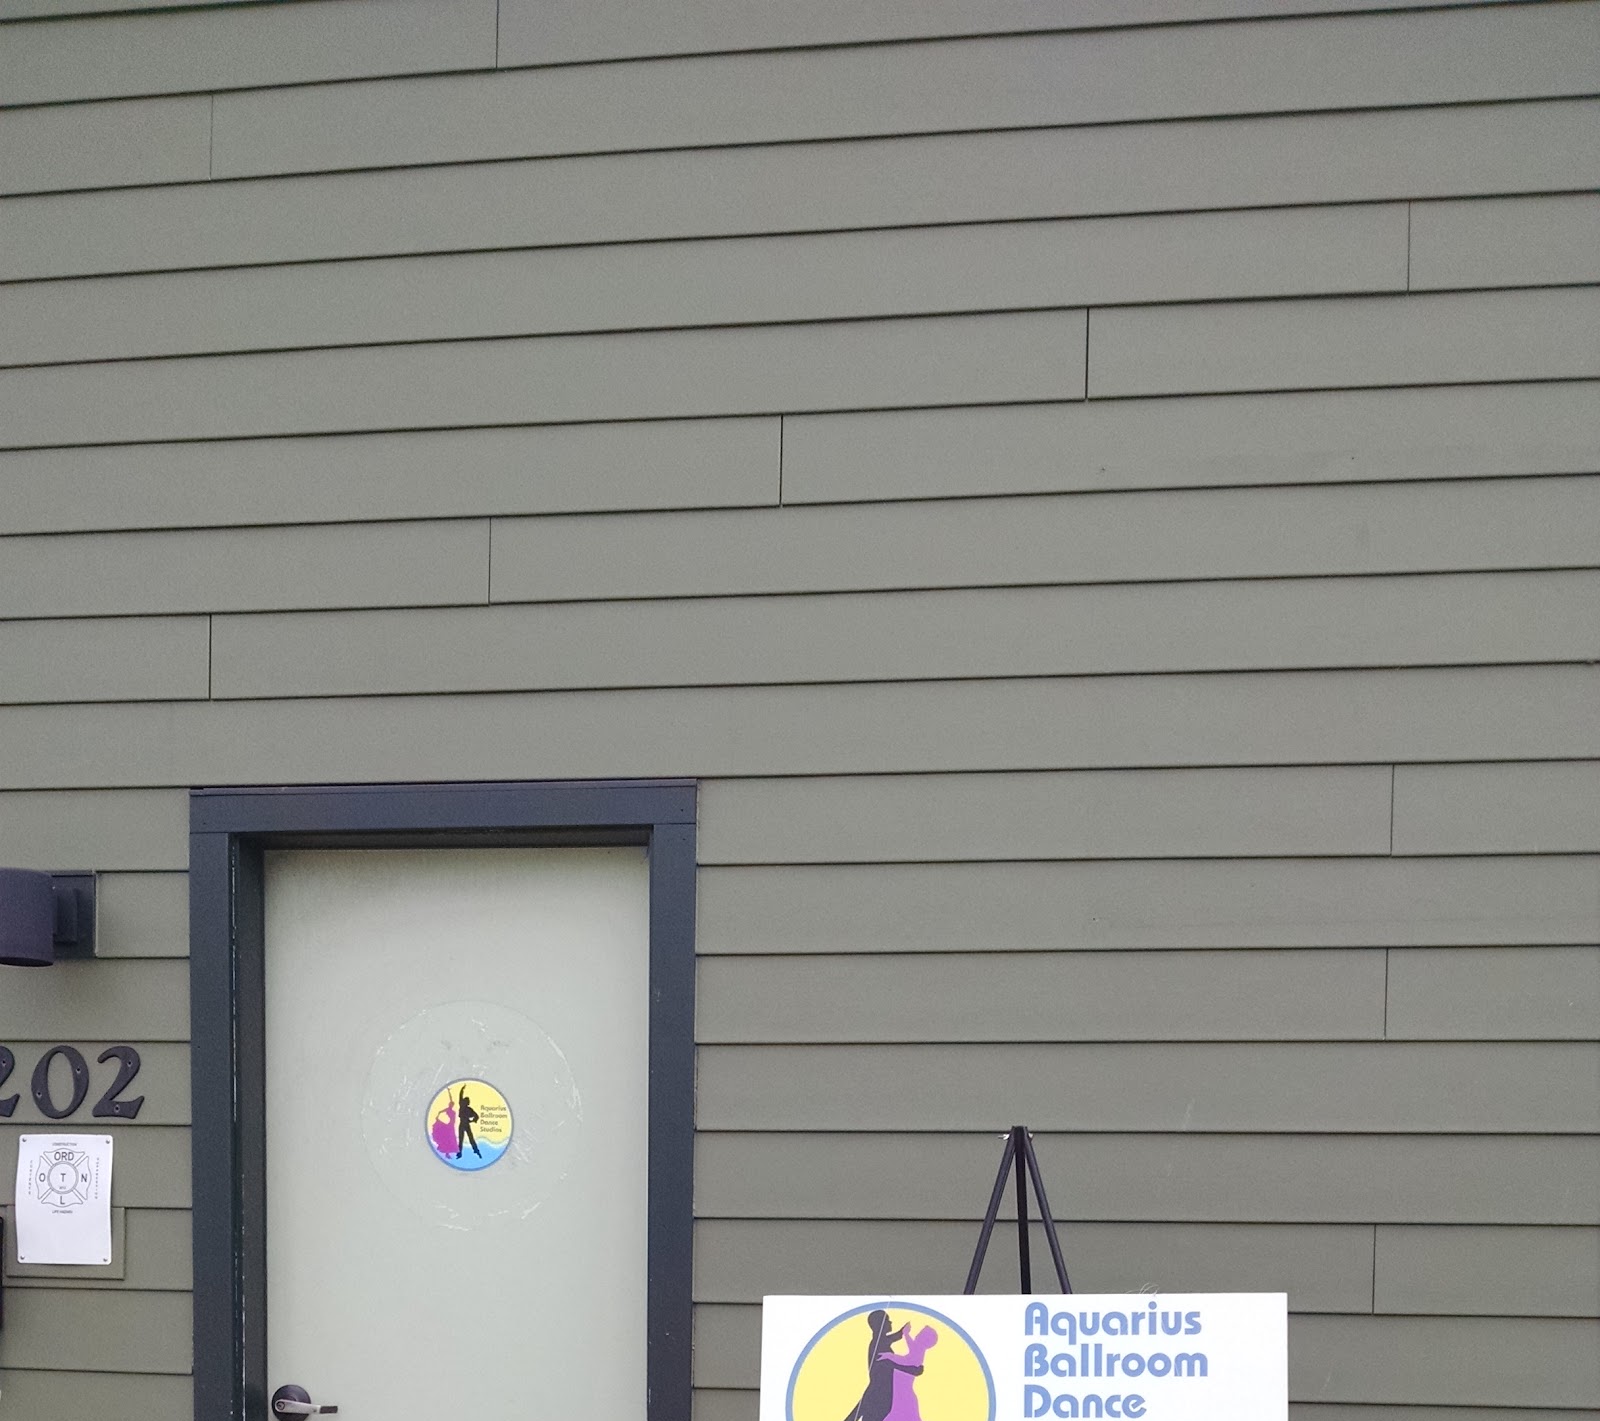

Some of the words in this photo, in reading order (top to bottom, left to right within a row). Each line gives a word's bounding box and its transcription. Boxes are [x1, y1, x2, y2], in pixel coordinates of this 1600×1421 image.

[54, 1151, 74, 1161] ORD
[60, 1173, 66, 1182] T
[80, 1173, 88, 1183] N
[60, 1195, 66, 1205] L
[1023, 1301, 1203, 1348] Aquarius
[1023, 1343, 1209, 1378] Ballroom
[1023, 1384, 1147, 1419] Dance
